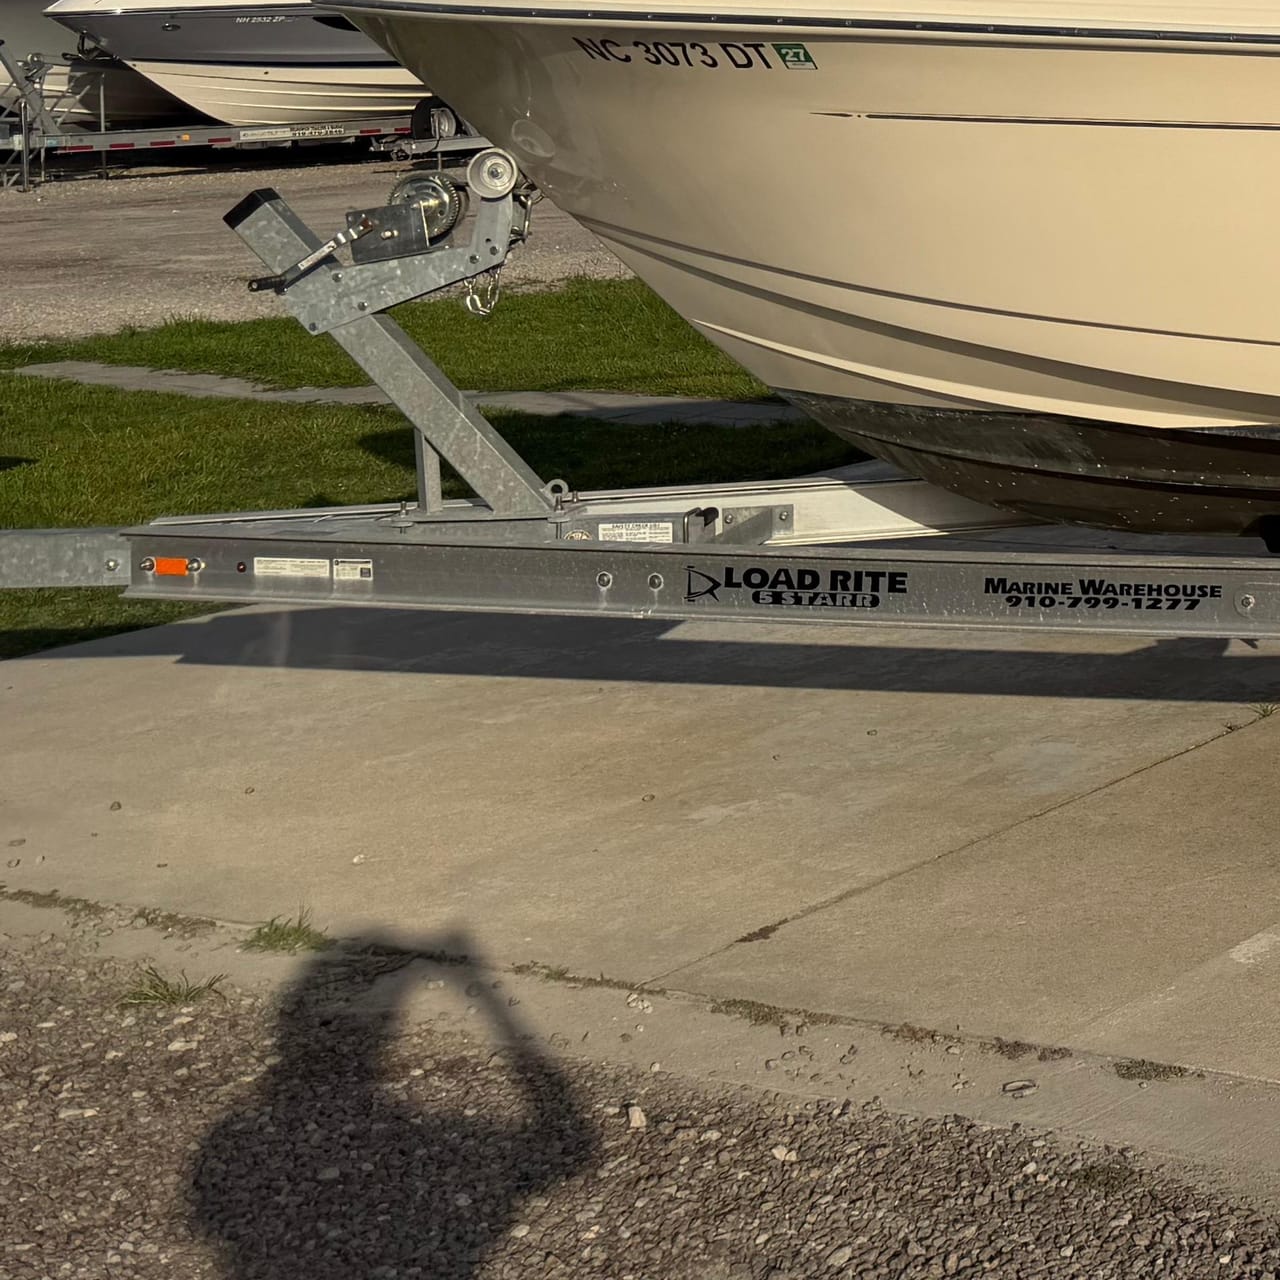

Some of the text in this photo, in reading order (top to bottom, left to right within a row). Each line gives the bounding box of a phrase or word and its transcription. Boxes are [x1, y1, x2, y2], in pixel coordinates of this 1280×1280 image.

[572, 36, 773, 69] NC 3073 DT
[781, 48, 806, 61] 27
[724, 567, 908, 593] LOAD RITE
[984, 578, 1222, 598] MARINE WAREHOUSE
[759, 592, 873, 607] 5 STARR
[1005, 596, 1201, 610] 910-799-1277
